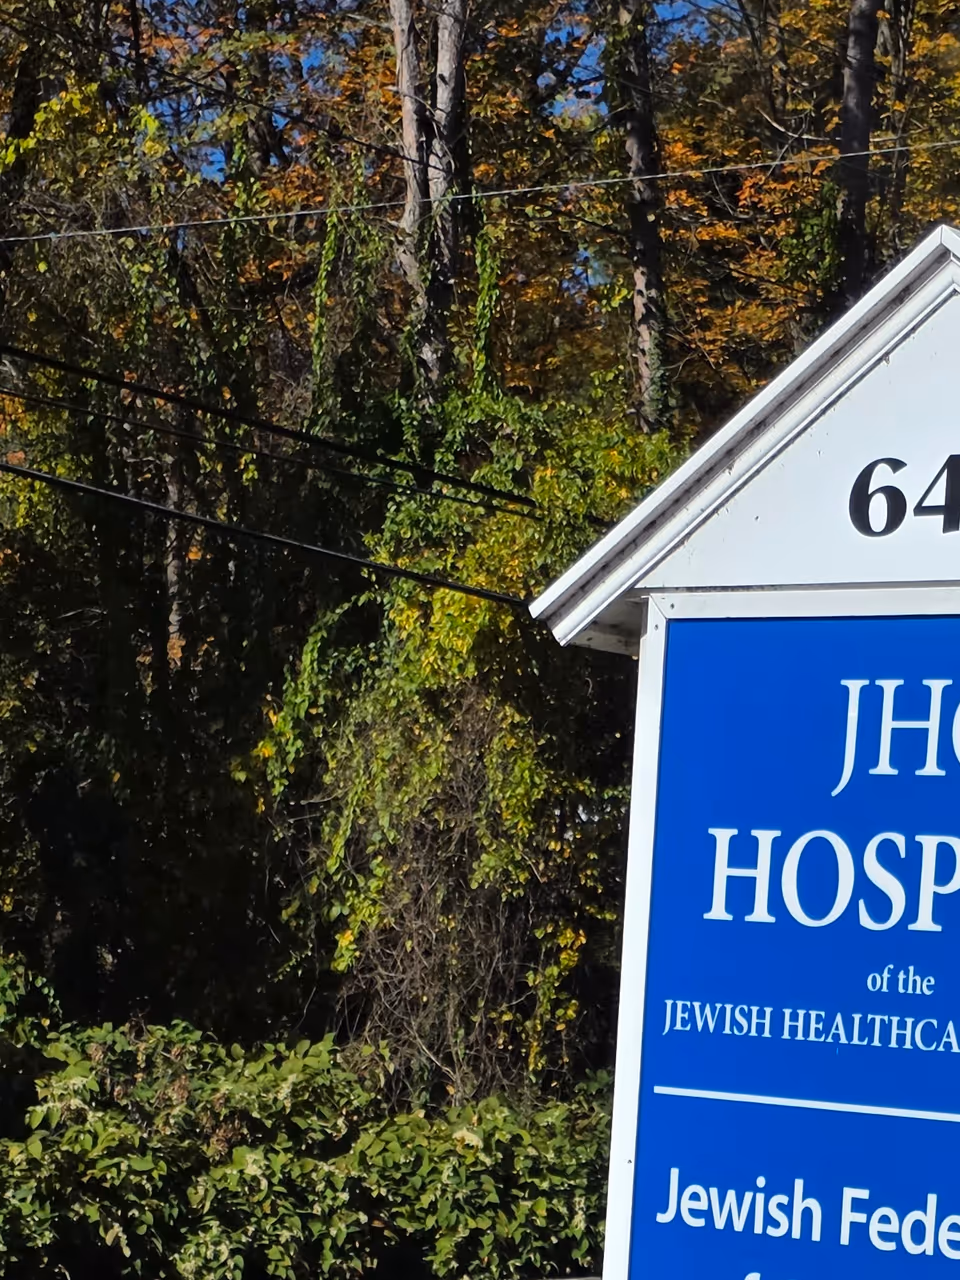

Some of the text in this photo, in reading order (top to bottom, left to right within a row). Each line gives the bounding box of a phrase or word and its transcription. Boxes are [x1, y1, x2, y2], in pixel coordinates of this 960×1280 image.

[866, 964, 935, 995] of the
[662, 999, 773, 1041] JEWISH
[655, 1167, 822, 1242] Jewish
